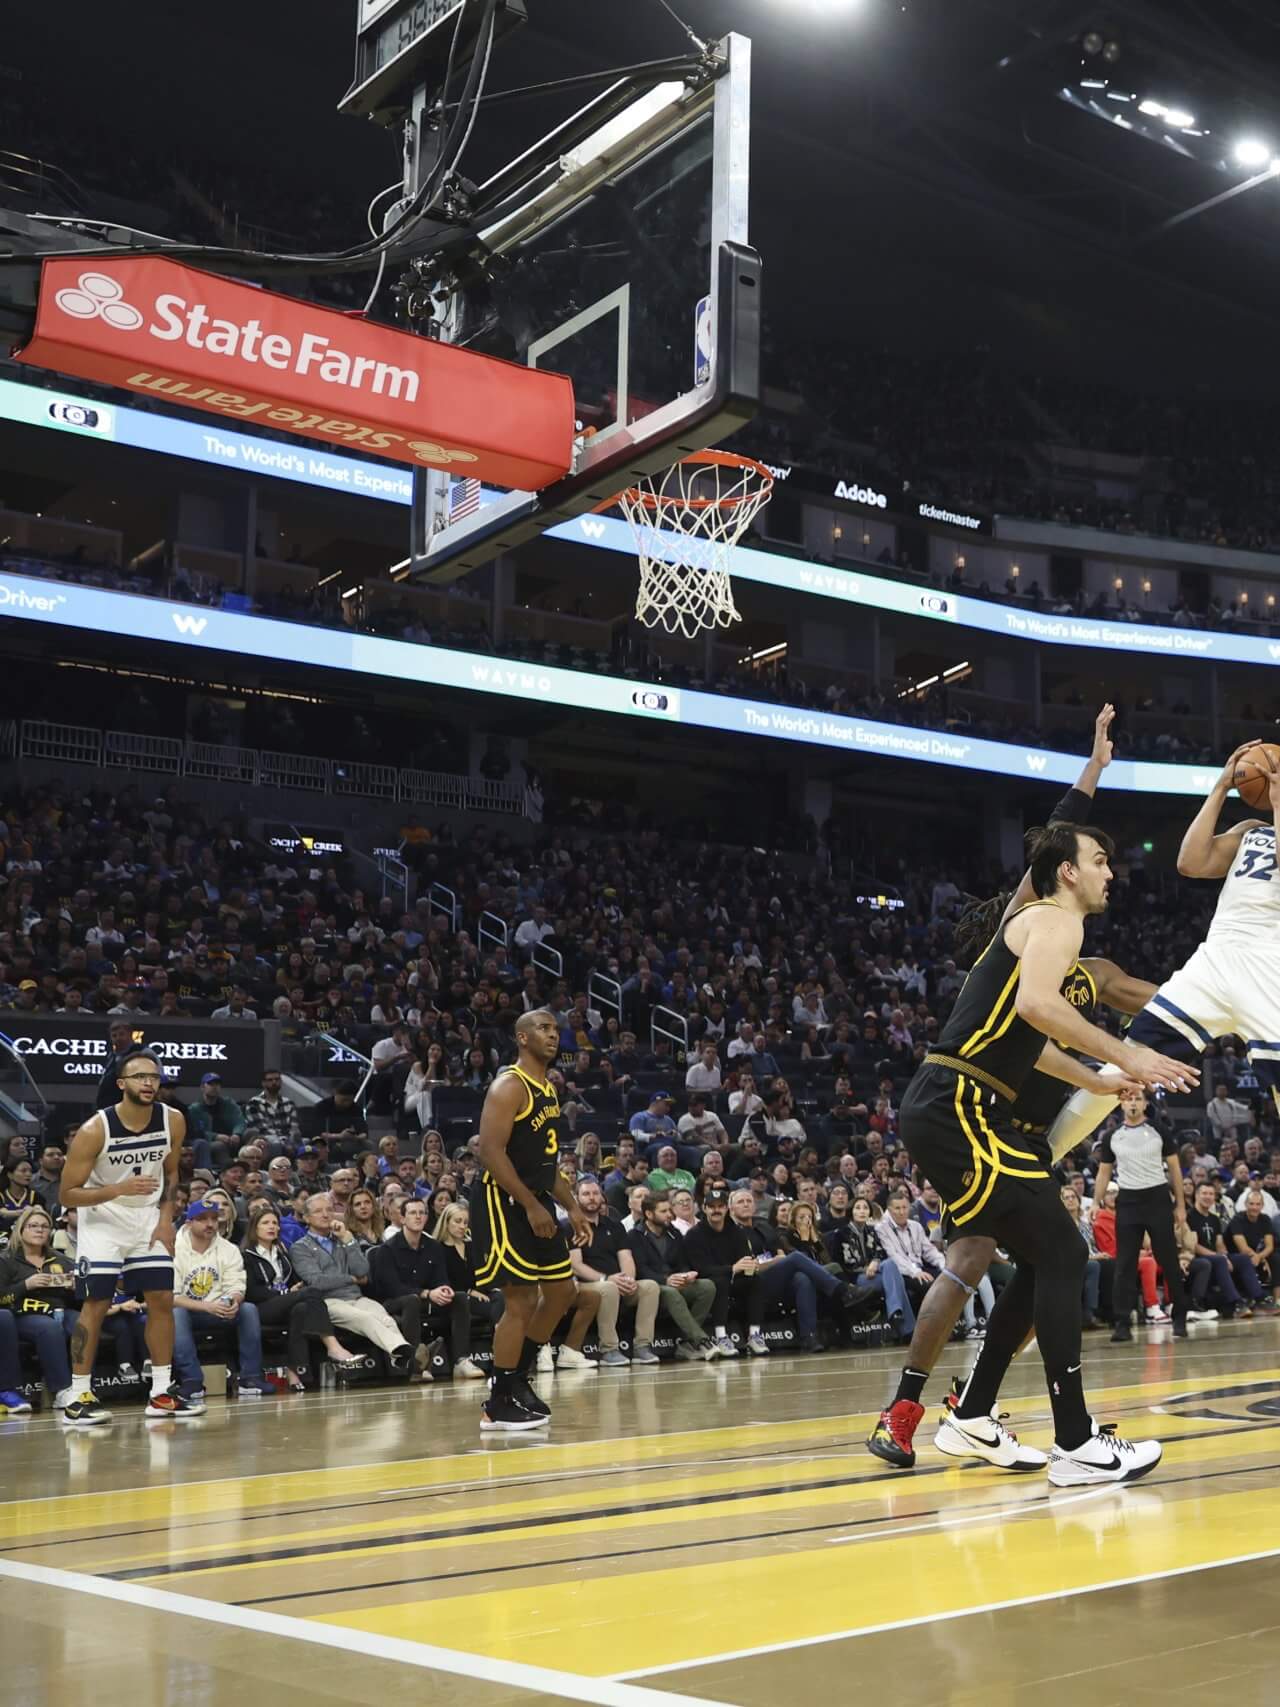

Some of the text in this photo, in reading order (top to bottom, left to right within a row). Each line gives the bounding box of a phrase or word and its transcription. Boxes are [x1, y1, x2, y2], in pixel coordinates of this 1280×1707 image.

[204, 436, 413, 498] The World's Most Experie
[834, 480, 887, 509] Adobe
[918, 503, 981, 530] ticketmaster
[799, 570, 859, 594] WAYMO
[1006, 614, 1026, 631] The
[1071, 623, 1100, 641] Most
[472, 665, 551, 691] WAYMO
[744, 709, 769, 728] The
[772, 714, 820, 736] World's
[822, 723, 853, 742] Most
[855, 728, 930, 754] Experienced
[1244, 835, 1276, 850] WOL
[1234, 850, 1278, 881] 32
[13, 1038, 228, 1060] CACHE CREEK
[64, 1063, 106, 1075] CASIN
[545, 1128, 558, 1155] 3
[108, 1150, 164, 1166] WOLVES
[758, 1331, 784, 1341] HASE
